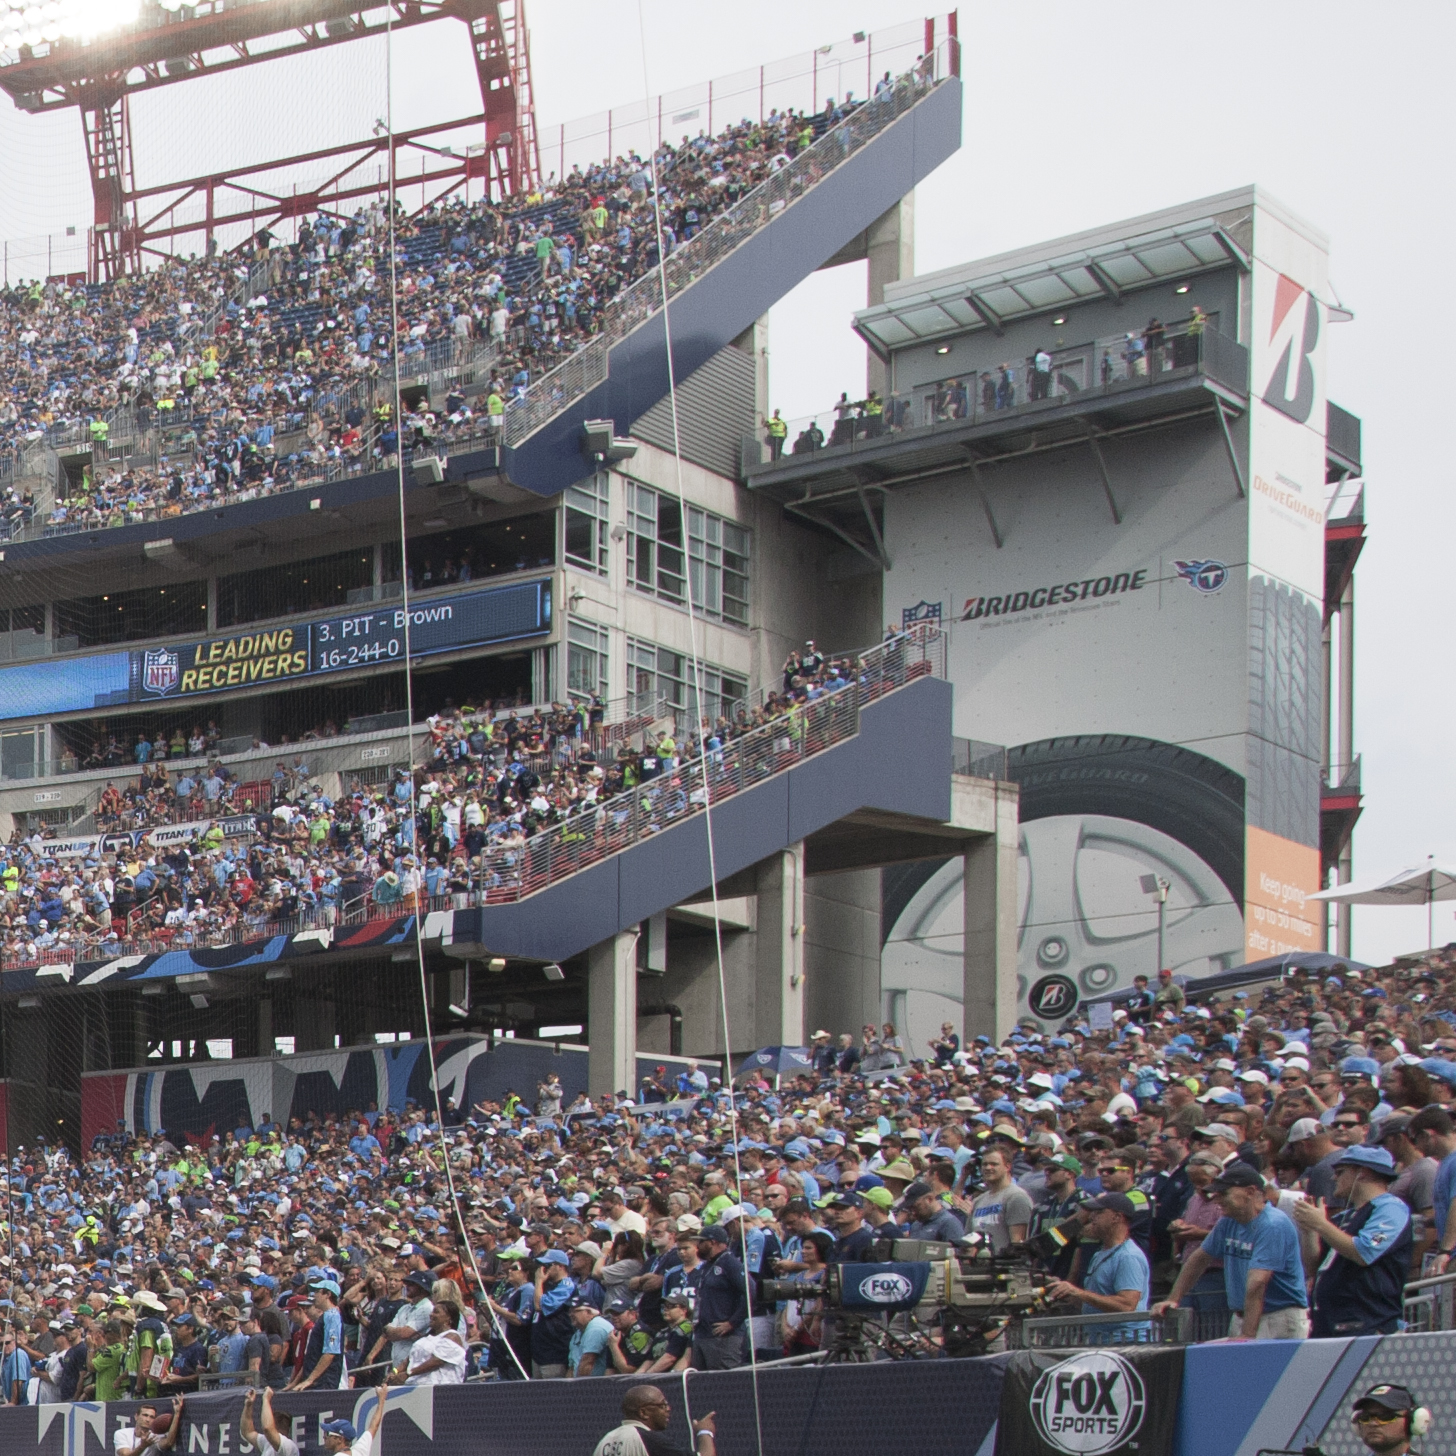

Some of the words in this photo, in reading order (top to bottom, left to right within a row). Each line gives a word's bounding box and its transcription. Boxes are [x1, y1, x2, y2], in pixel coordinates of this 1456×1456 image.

[962, 570, 1147, 621] BRIDGESTONE
[319, 624, 335, 642] 3.
[342, 616, 374, 638] PIT
[394, 605, 453, 628] Brown
[194, 629, 294, 666] LEADING
[320, 639, 400, 670] 16-244-0
[181, 651, 307, 692] RECEIVERS
[871, 1279, 900, 1291] FOX
[1054, 1371, 1121, 1416] FOX
[1050, 1417, 1118, 1435] SPORTS
